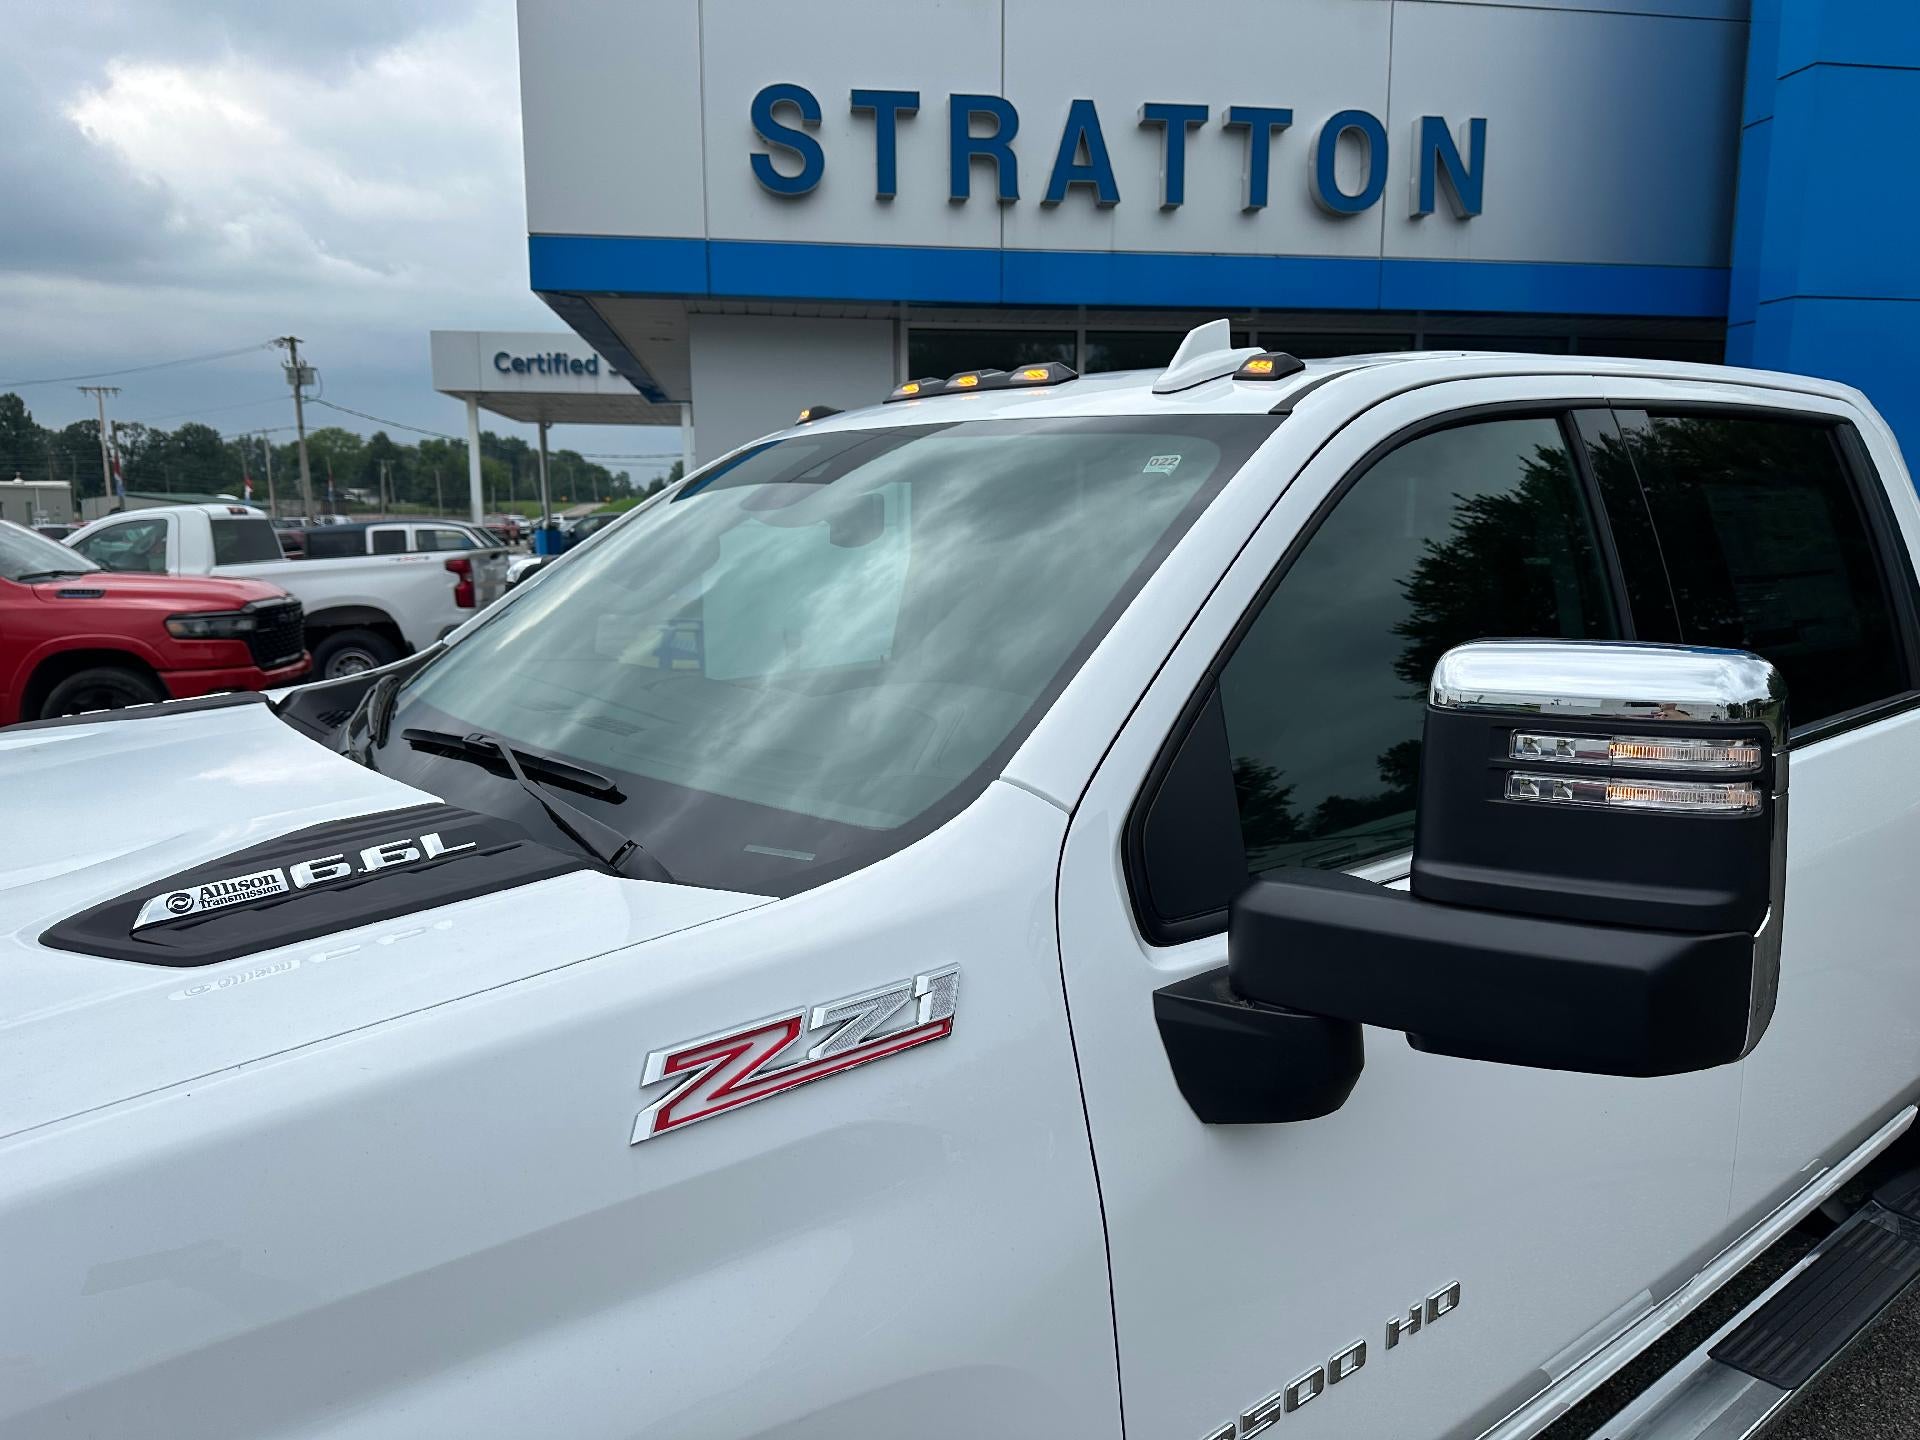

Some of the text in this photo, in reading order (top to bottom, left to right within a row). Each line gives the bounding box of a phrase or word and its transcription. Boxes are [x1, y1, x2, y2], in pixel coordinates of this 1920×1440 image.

[750, 83, 1487, 219] STRATTON
[494, 351, 599, 375] Certified
[1150, 457, 1178, 466] 022
[289, 832, 477, 889] 6.6L
[198, 884, 282, 910] Transmission
[200, 874, 280, 901] Allison
[630, 962, 960, 1146] Z71
[1385, 1280, 1461, 1350] HD
